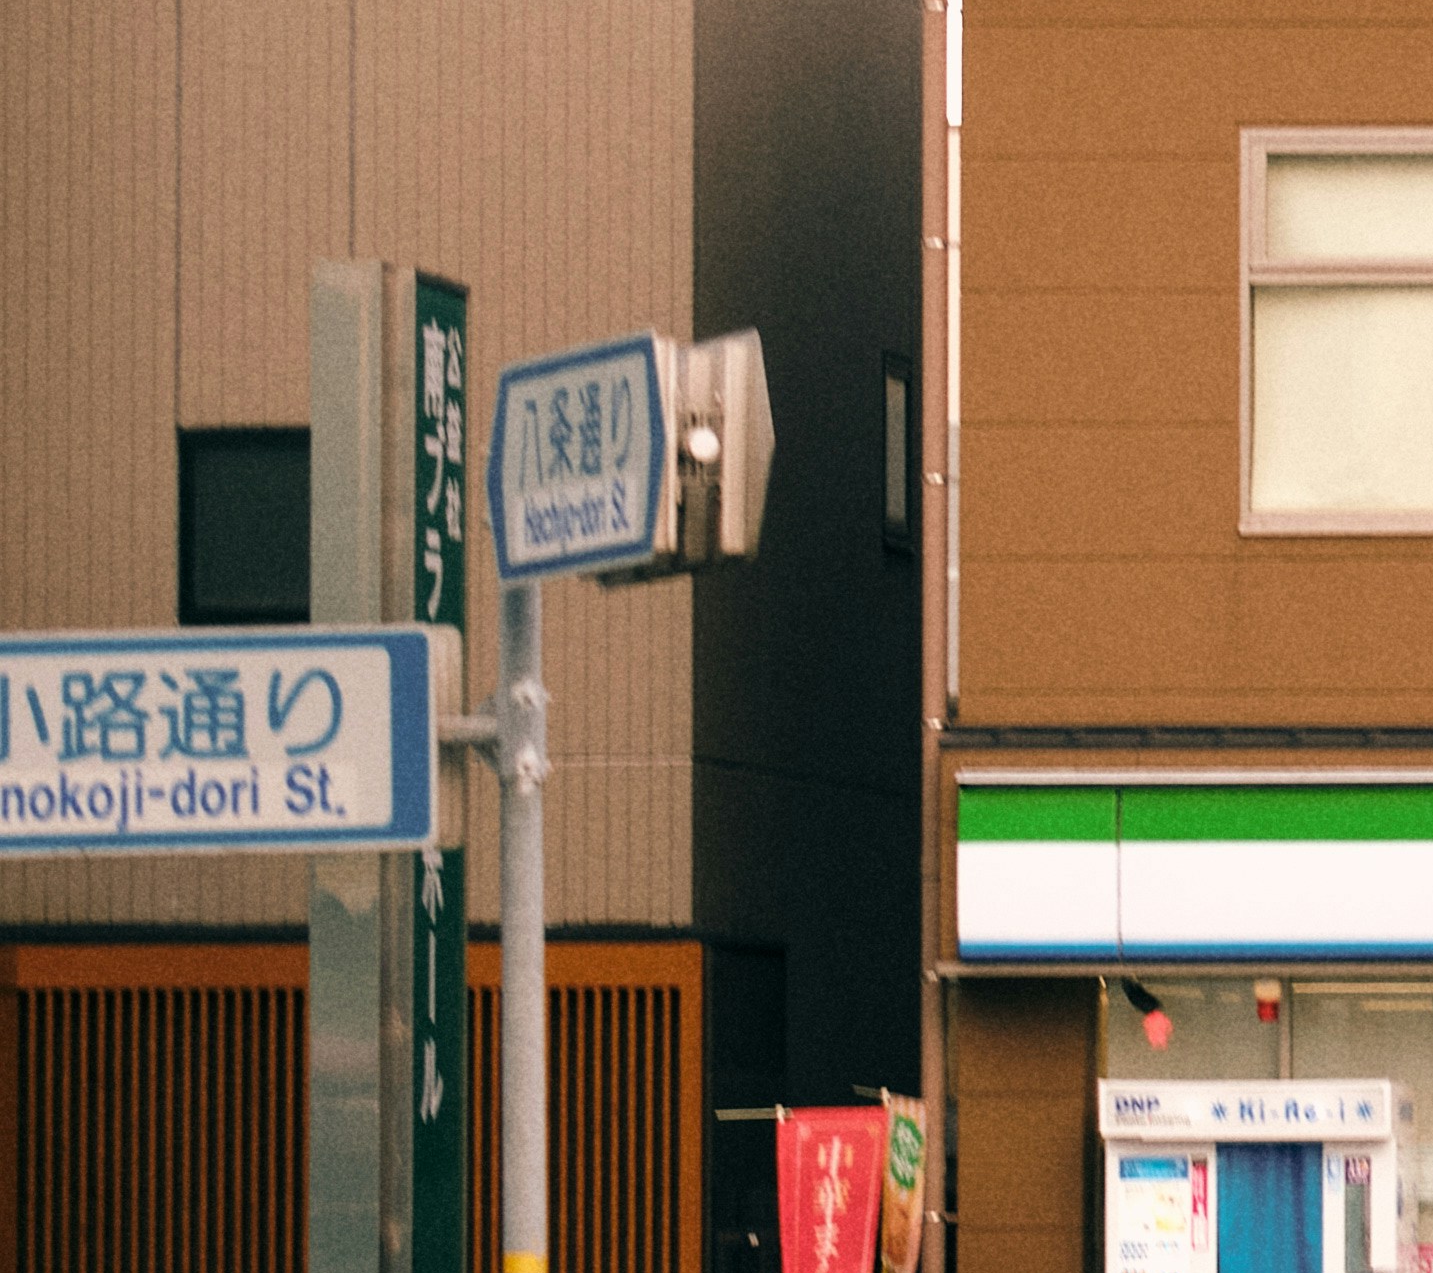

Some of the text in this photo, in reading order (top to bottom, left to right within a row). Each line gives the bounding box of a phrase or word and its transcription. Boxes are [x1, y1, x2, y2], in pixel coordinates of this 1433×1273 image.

[518, 376, 633, 494] 八条通り
[285, 762, 347, 818] St.
